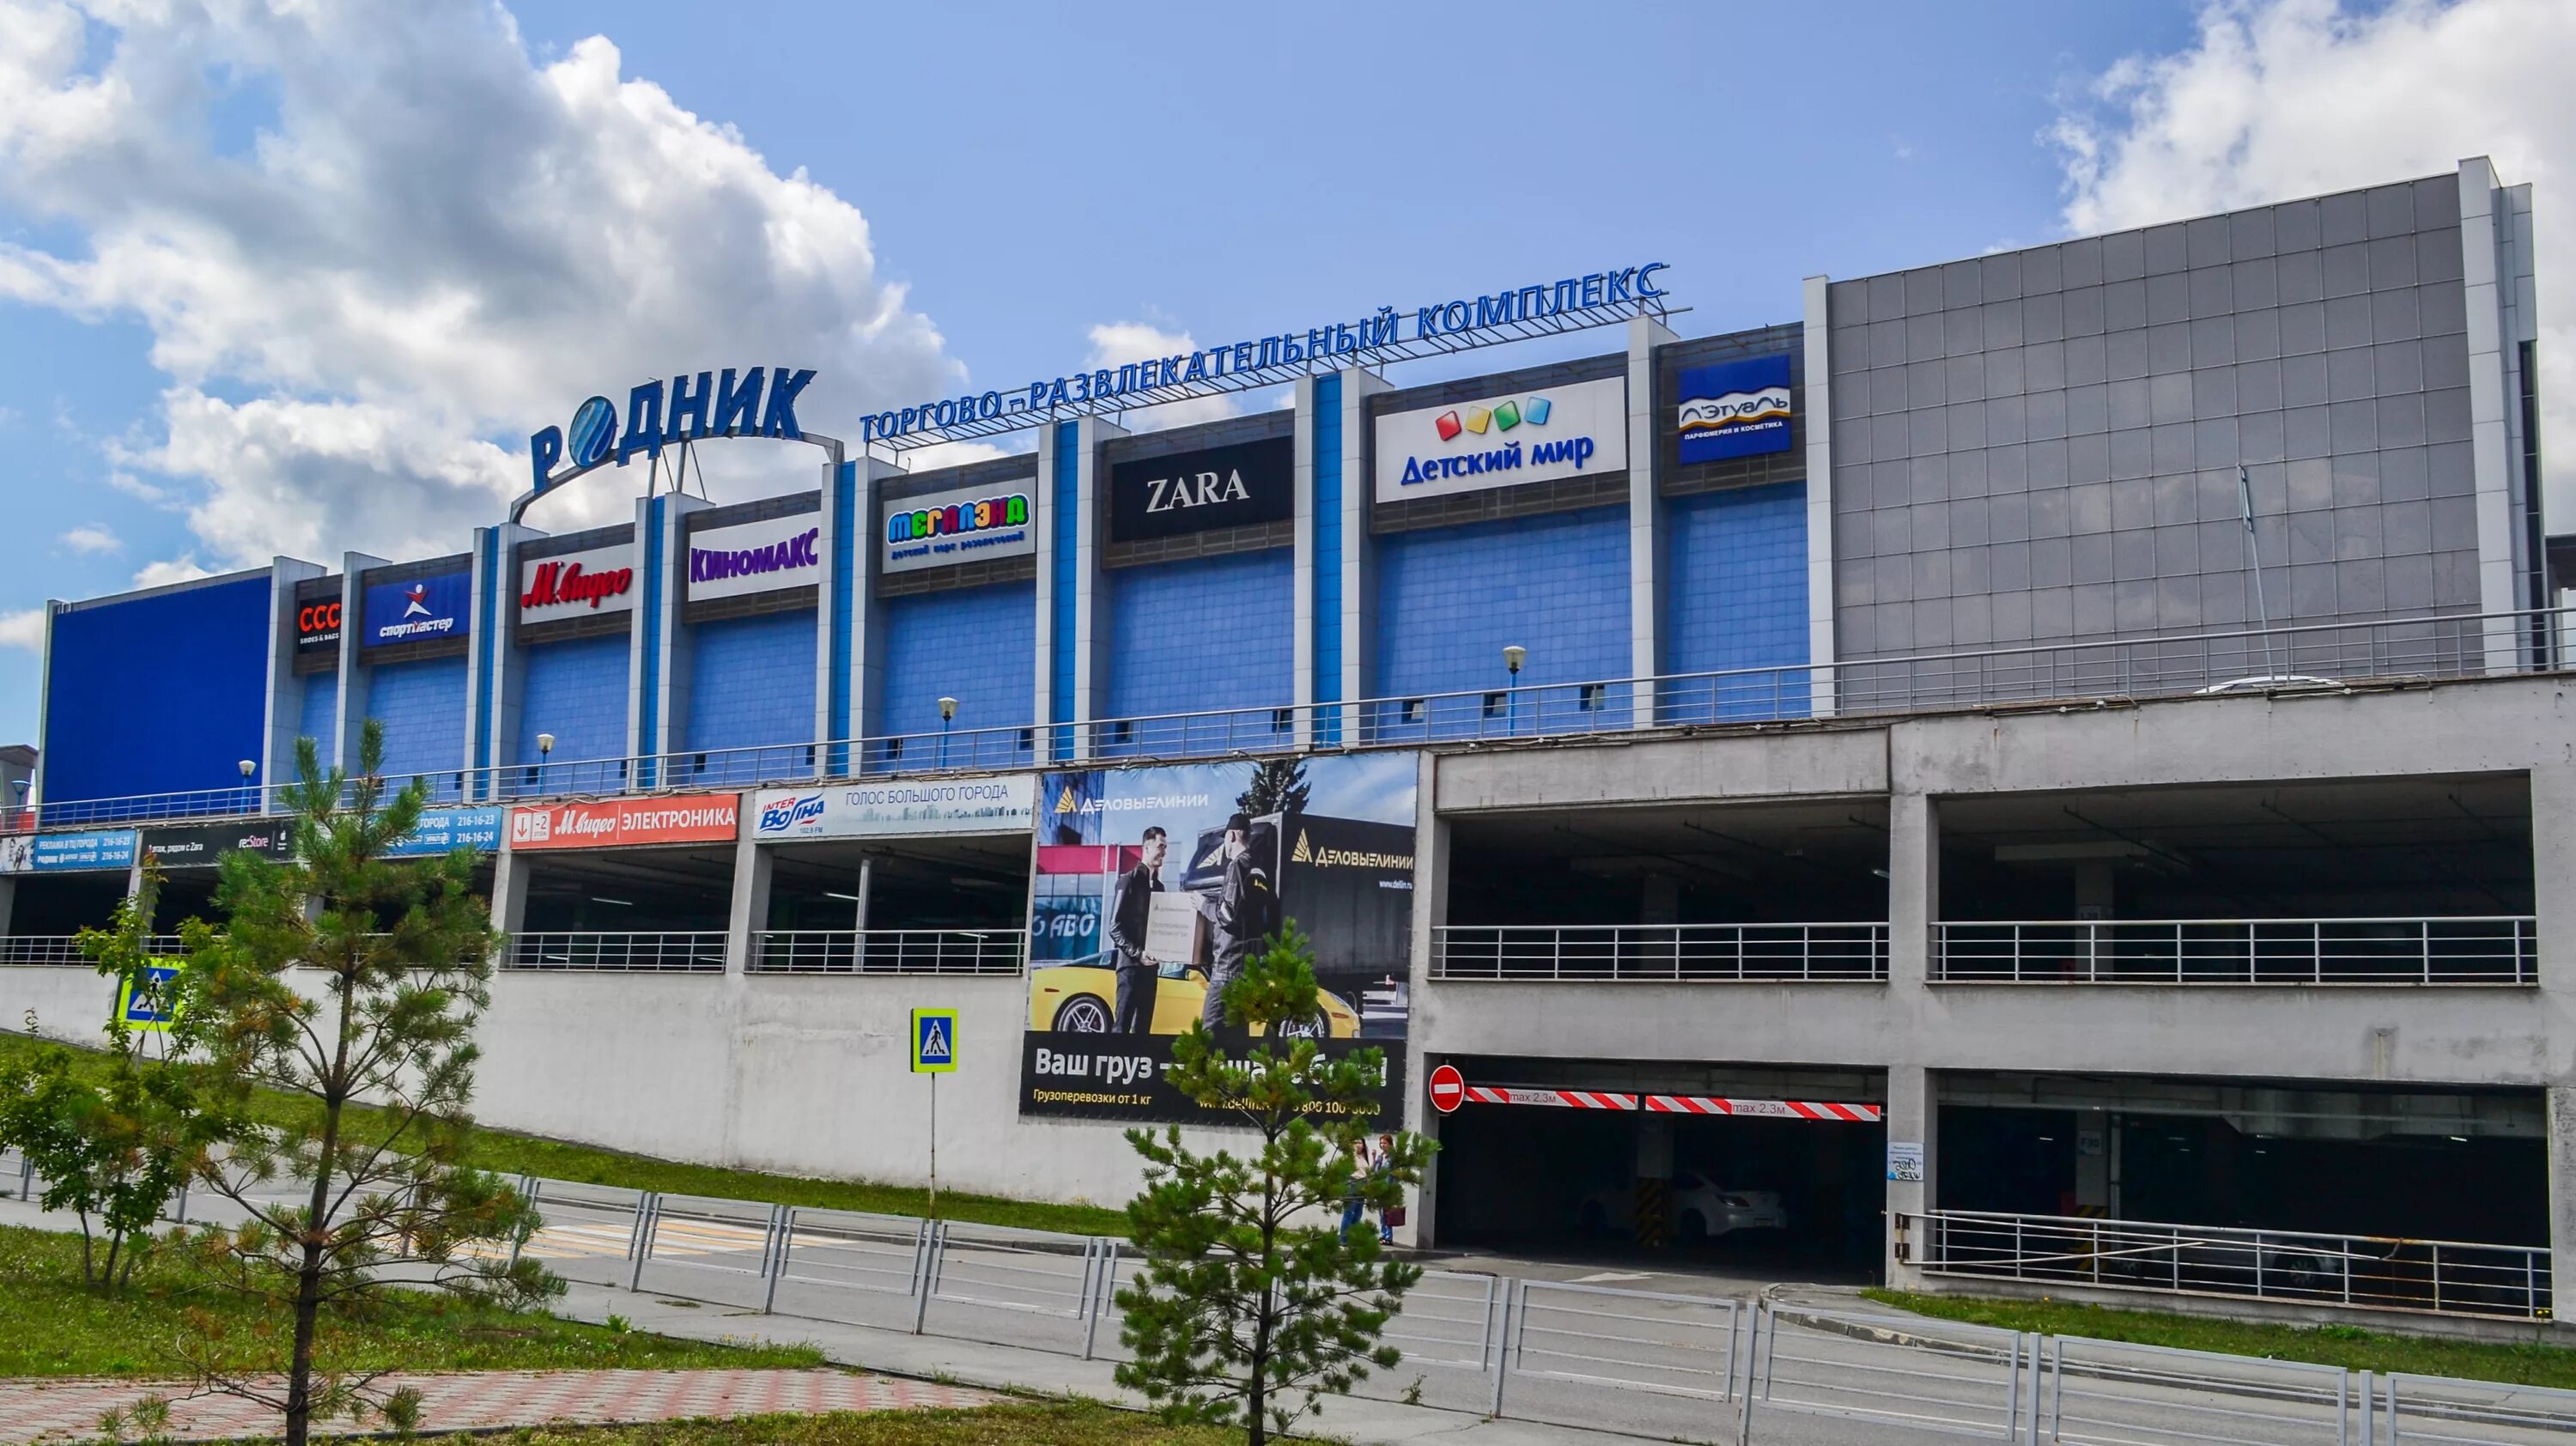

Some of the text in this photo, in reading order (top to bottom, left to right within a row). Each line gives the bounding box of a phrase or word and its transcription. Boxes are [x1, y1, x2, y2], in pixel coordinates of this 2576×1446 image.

[1417, 261, 1664, 339] КОМПЛЕКС
[530, 366, 818, 495] РОДНИК
[1684, 428, 1733, 440] ПАРФЮМЕРИЯ
[1741, 421, 1783, 433] КОСМЕТИКА
[1400, 436, 1595, 486] Детский мир
[1145, 468, 1251, 513] ZARA
[690, 526, 819, 584] КИНОМАКС
[325, 632, 339, 641] BAGS
[846, 784, 1009, 807] ГОЛОС БОЛЬШОГО ГОРОДА
[762, 797, 797, 814] INTER
[419, 817, 450, 829] ГОРОДА
[457, 815, 495, 827] 216-16-23
[536, 816, 548, 829] -2
[622, 807, 736, 831] ЭЛЕКТРОНИКА
[238, 835, 269, 848] re:Store
[456, 831, 494, 843] 216-16-24
[1036, 1048, 1090, 1077] Ваш
[1095, 1055, 1152, 1084] груз
[1033, 1089, 1152, 1106] Грузоперевозки от 1 кг
[1510, 1092, 1530, 1102] max
[1302, 1100, 1323, 1113] 800
[1733, 1103, 1756, 1114] max
